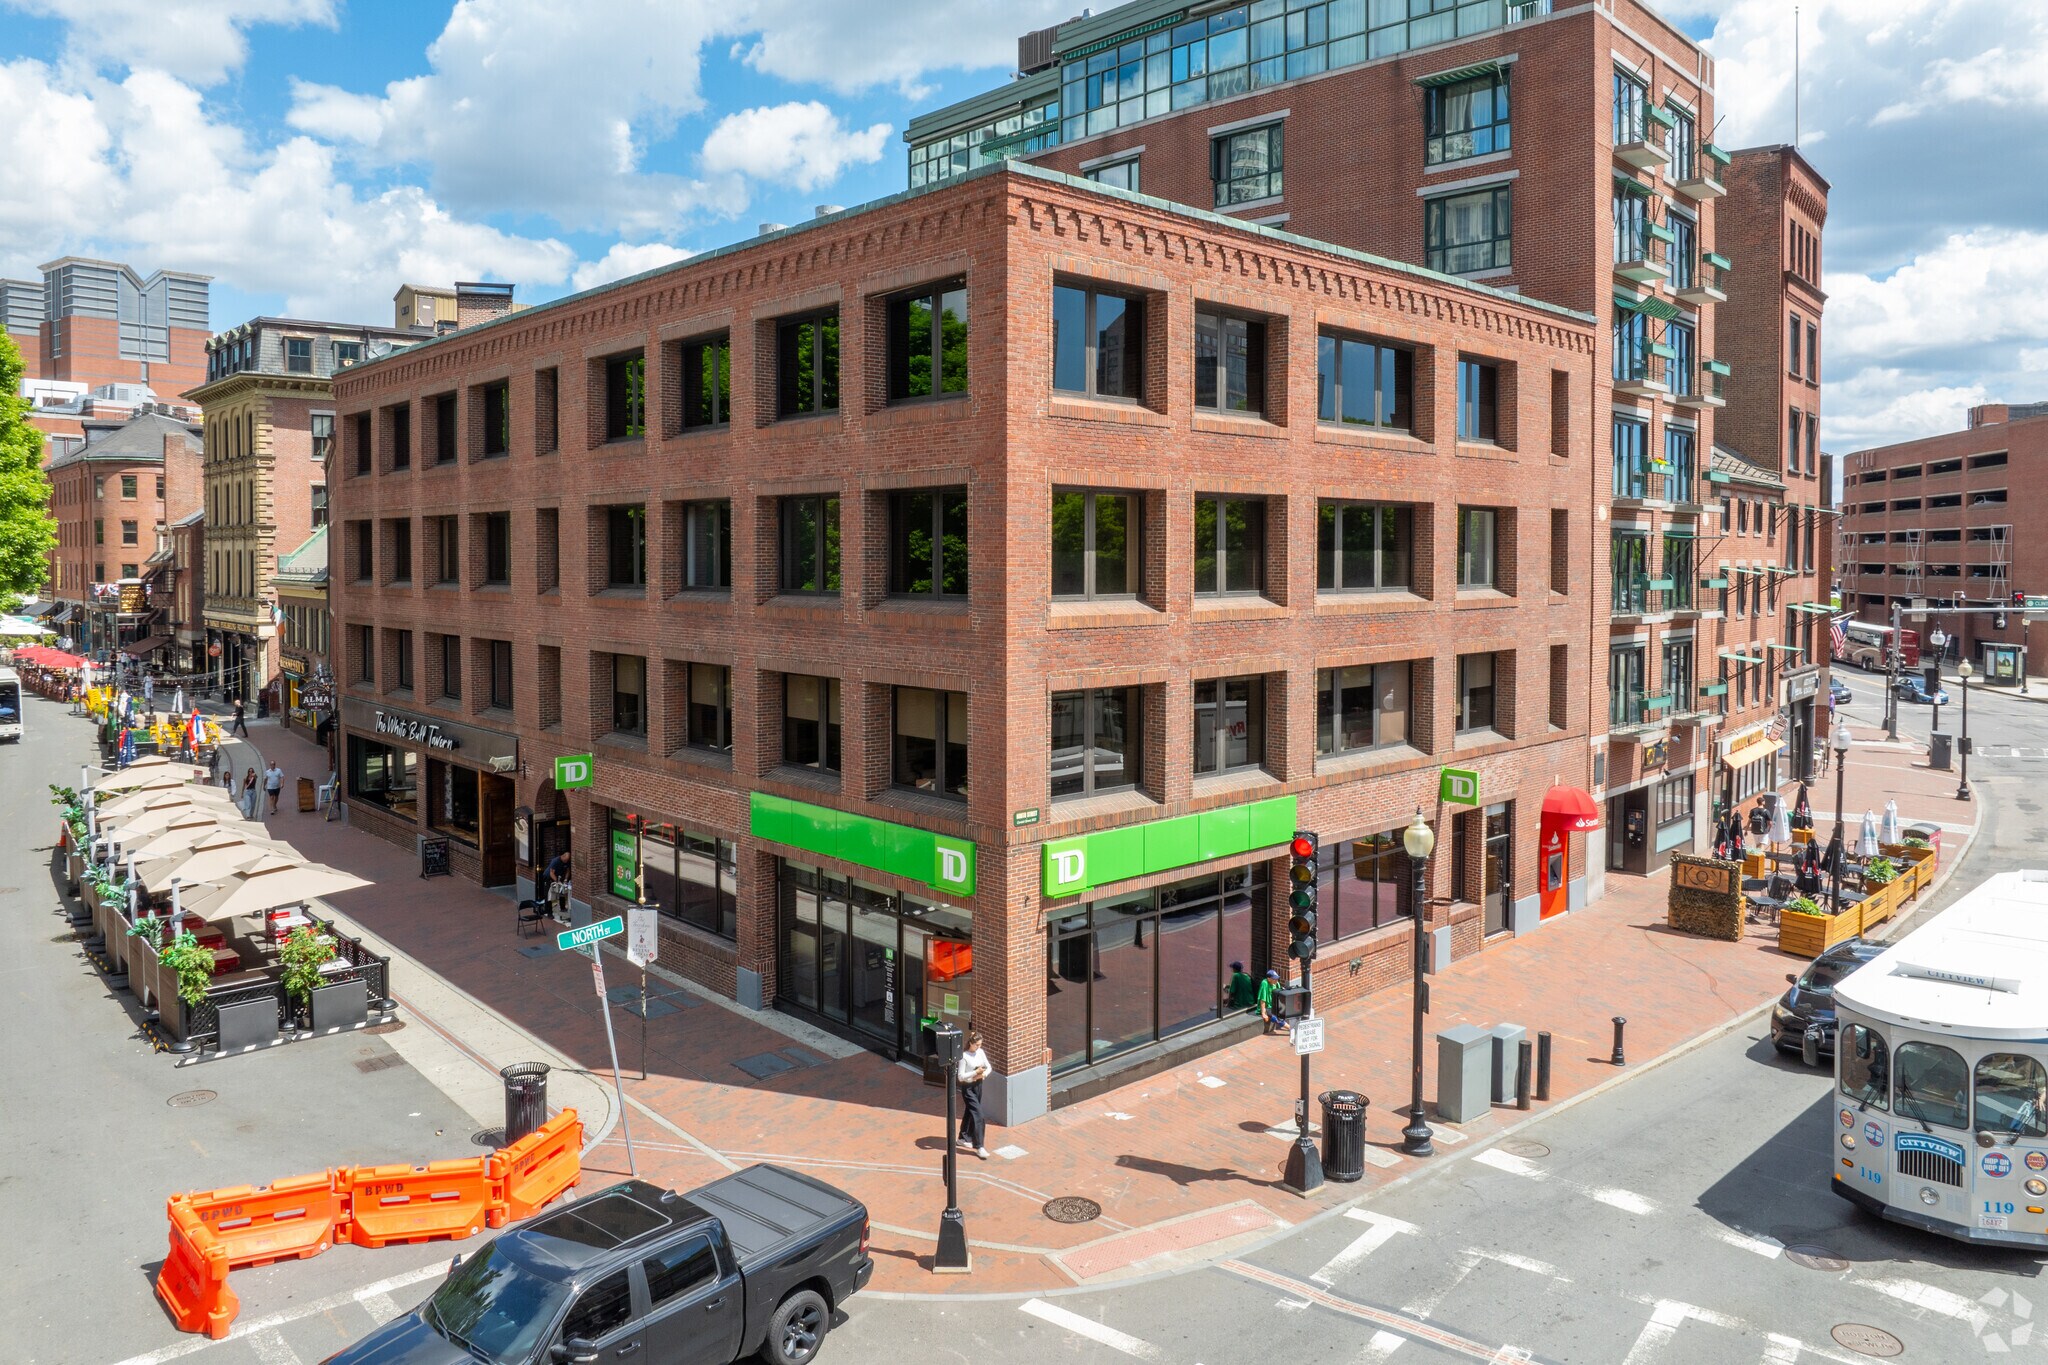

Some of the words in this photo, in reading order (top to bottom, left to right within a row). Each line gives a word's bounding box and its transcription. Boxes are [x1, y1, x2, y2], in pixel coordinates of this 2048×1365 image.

[303, 695, 330, 704] ALMA
[375, 711, 387, 732] The
[387, 716, 407, 738] White
[408, 721, 427, 743] Bull
[428, 725, 454, 750] Tavern
[560, 761, 588, 783] TD
[1446, 775, 1474, 799] TD
[614, 843, 634, 857] ENERGY
[937, 847, 967, 883] TD
[1051, 849, 1085, 886] TD
[571, 924, 604, 944] NORTH
[604, 926, 611, 935] ST
[1927, 970, 1986, 985] CITYVIEW
[1298, 1022, 1321, 1030] PEDESTRIANS
[1303, 1028, 1316, 1036] PLEASE
[1866, 1125, 1876, 1134] HOP
[1876, 1129, 1884, 1138] ON
[1866, 1131, 1875, 1140] HOP
[1875, 1135, 1884, 1144] OFF
[1900, 1138, 1960, 1157] CITYVIEW
[1860, 1166, 1881, 1184] 119
[1983, 1164, 1998, 1172] HOP
[365, 1183, 404, 1196] BPWD
[201, 1205, 243, 1221] BPWD
[1983, 1201, 2015, 1214] 119
